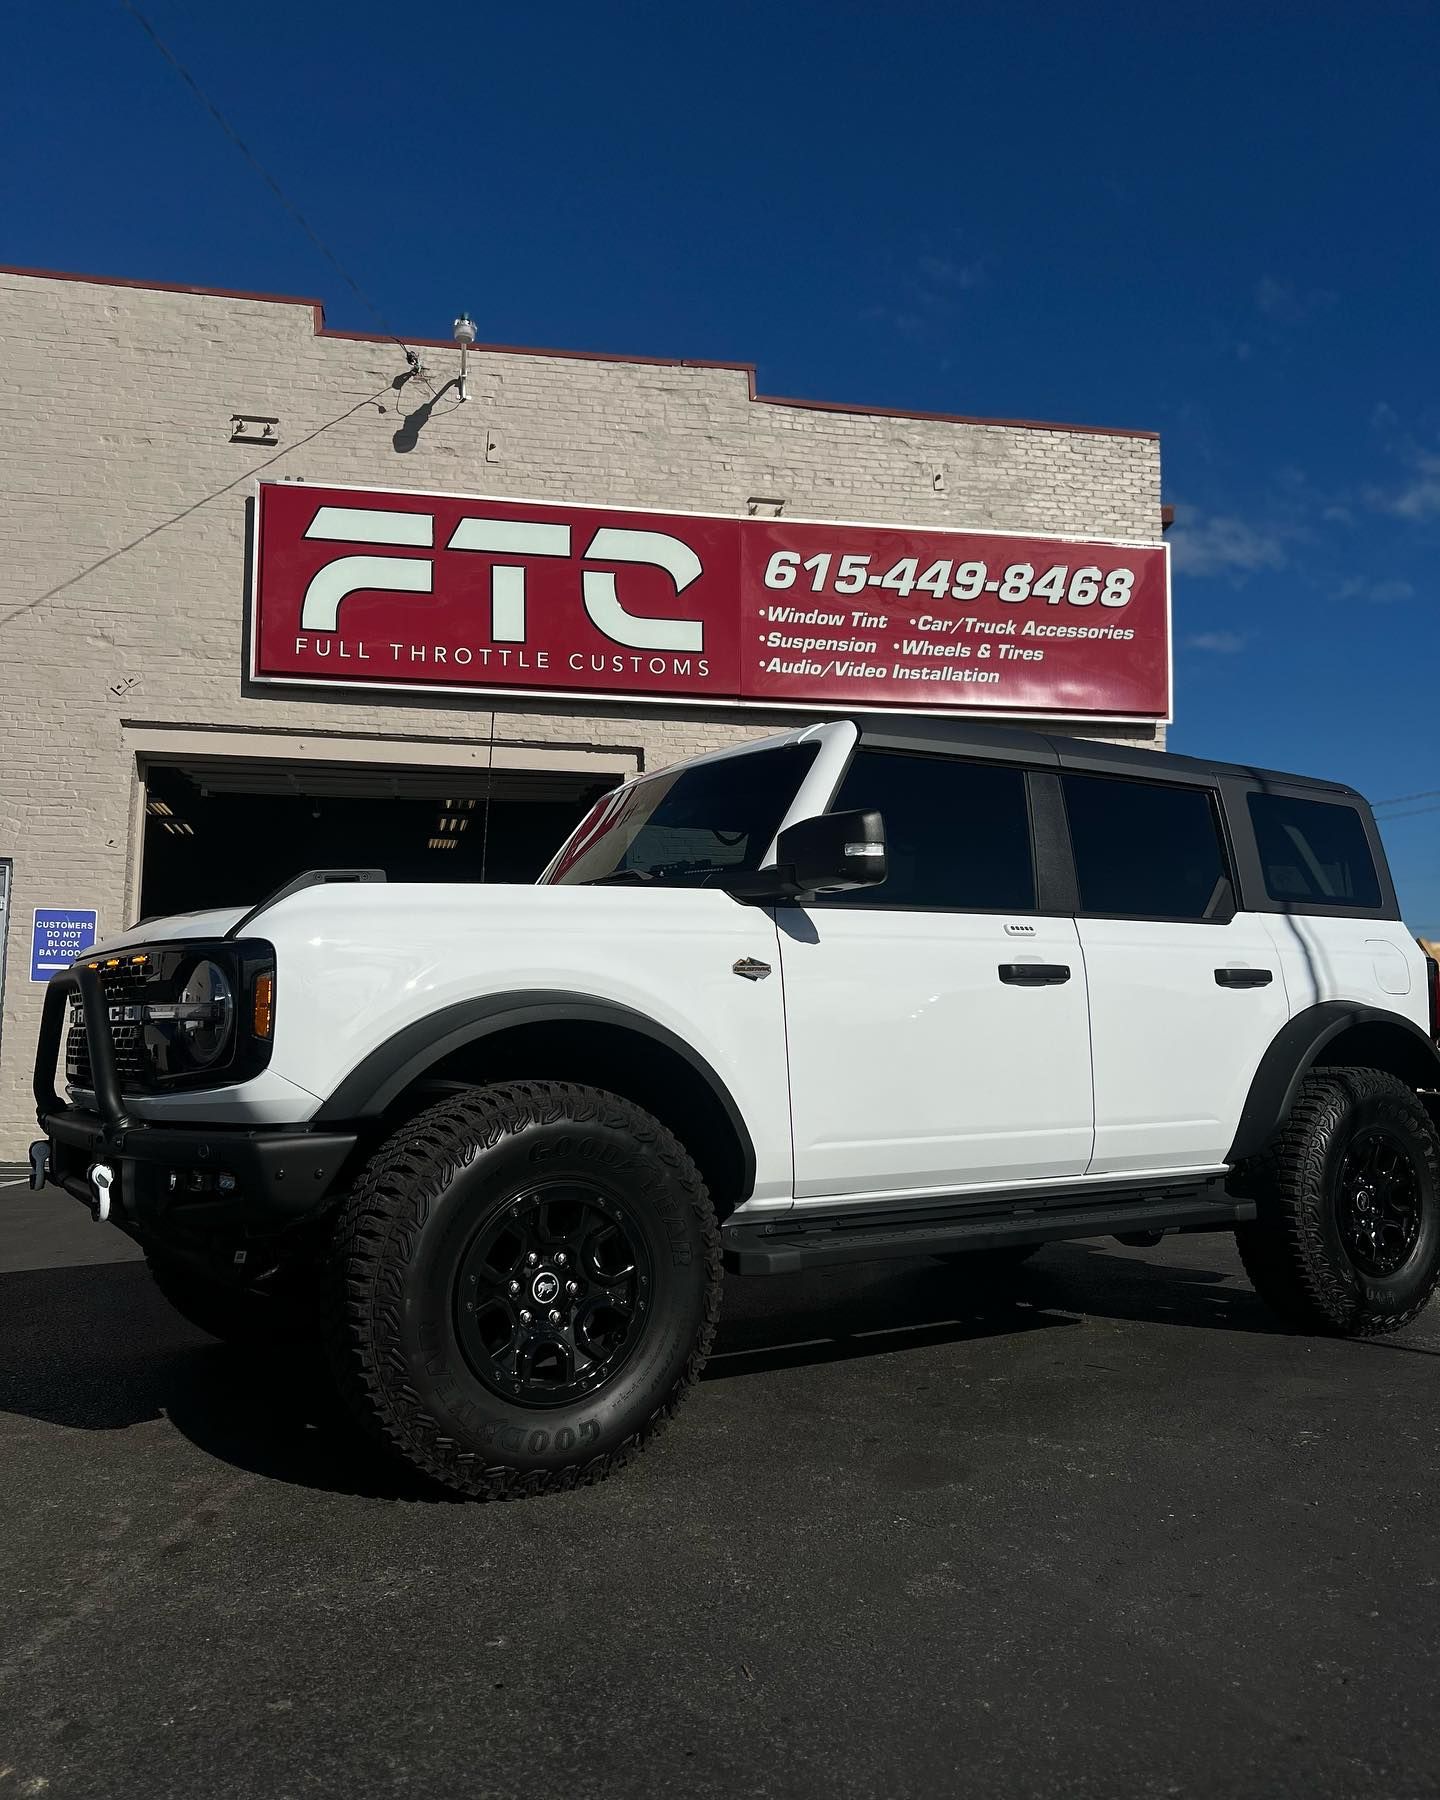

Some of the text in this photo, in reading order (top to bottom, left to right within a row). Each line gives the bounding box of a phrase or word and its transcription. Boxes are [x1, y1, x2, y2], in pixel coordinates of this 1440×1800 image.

[303, 506, 703, 652] FTC
[763, 550, 1135, 607] 615-449-8468
[768, 606, 888, 629] Window Tint
[917, 615, 1134, 640] Car/Truck Accessories
[767, 631, 878, 654] Suspension
[902, 640, 1044, 661] Wheels & Tires
[295, 637, 709, 676] FULL THROTTLE CUSTOMS
[766, 657, 1000, 684] Audio/Video Installation
[36, 921, 94, 930] CUSTOMERS
[48, 940, 80, 948] BLOCK
[61, 949, 81, 957] DOO
